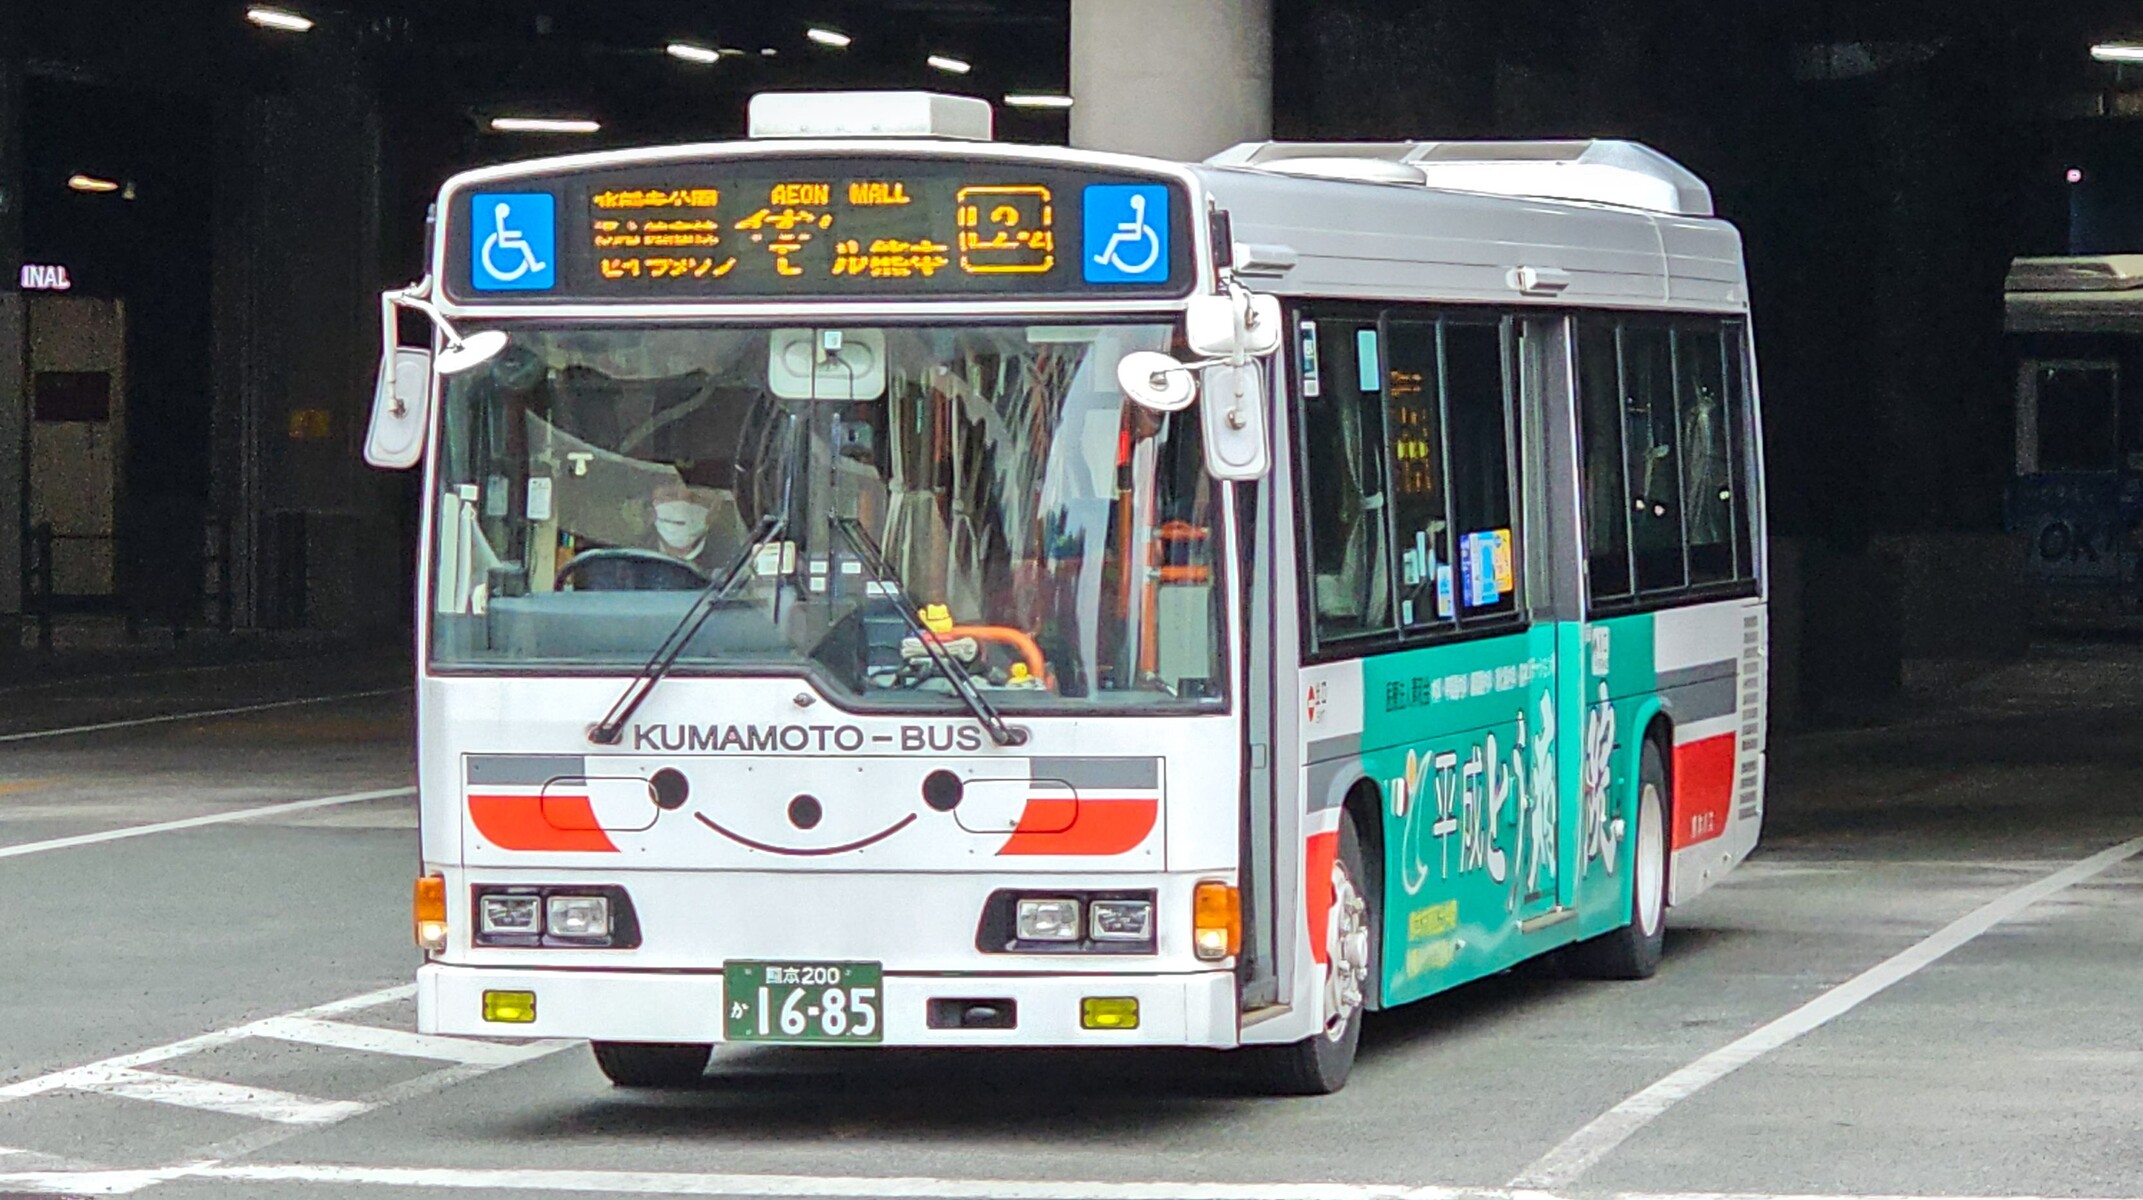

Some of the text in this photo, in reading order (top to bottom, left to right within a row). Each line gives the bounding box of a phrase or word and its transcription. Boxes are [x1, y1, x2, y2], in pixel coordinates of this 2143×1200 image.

[771, 182, 911, 205] AEON MALL
[21, 264, 71, 290] INAL
